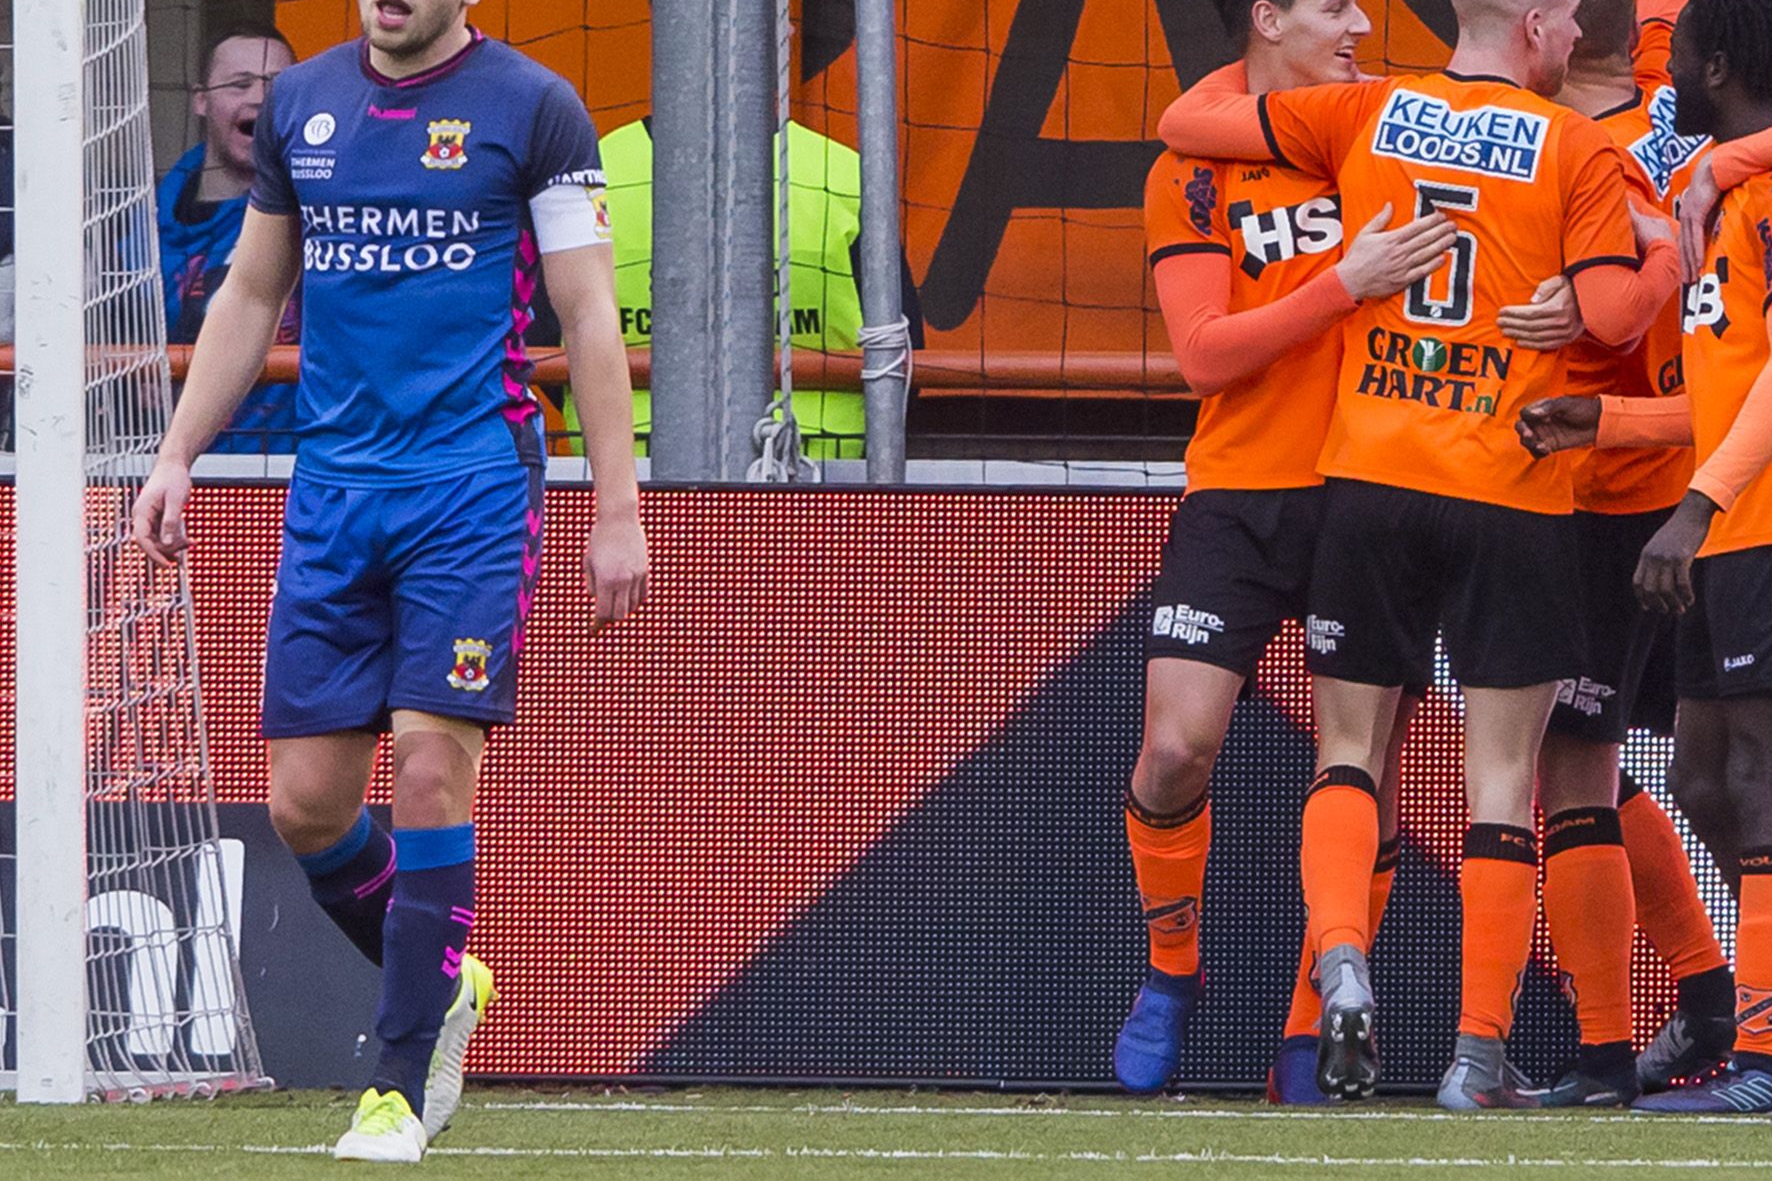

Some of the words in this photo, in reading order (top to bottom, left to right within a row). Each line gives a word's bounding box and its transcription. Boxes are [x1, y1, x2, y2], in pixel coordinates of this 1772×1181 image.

[1388, 94, 1541, 146] KEUKEN
[1378, 124, 1530, 175] LOODS.NL
[300, 205, 480, 239] THERMEN
[303, 238, 477, 272] BUSSLOO
[1356, 364, 1502, 417] HART.nl
[1176, 604, 1225, 627] Euro-
[1171, 622, 1210, 645] Rijn
